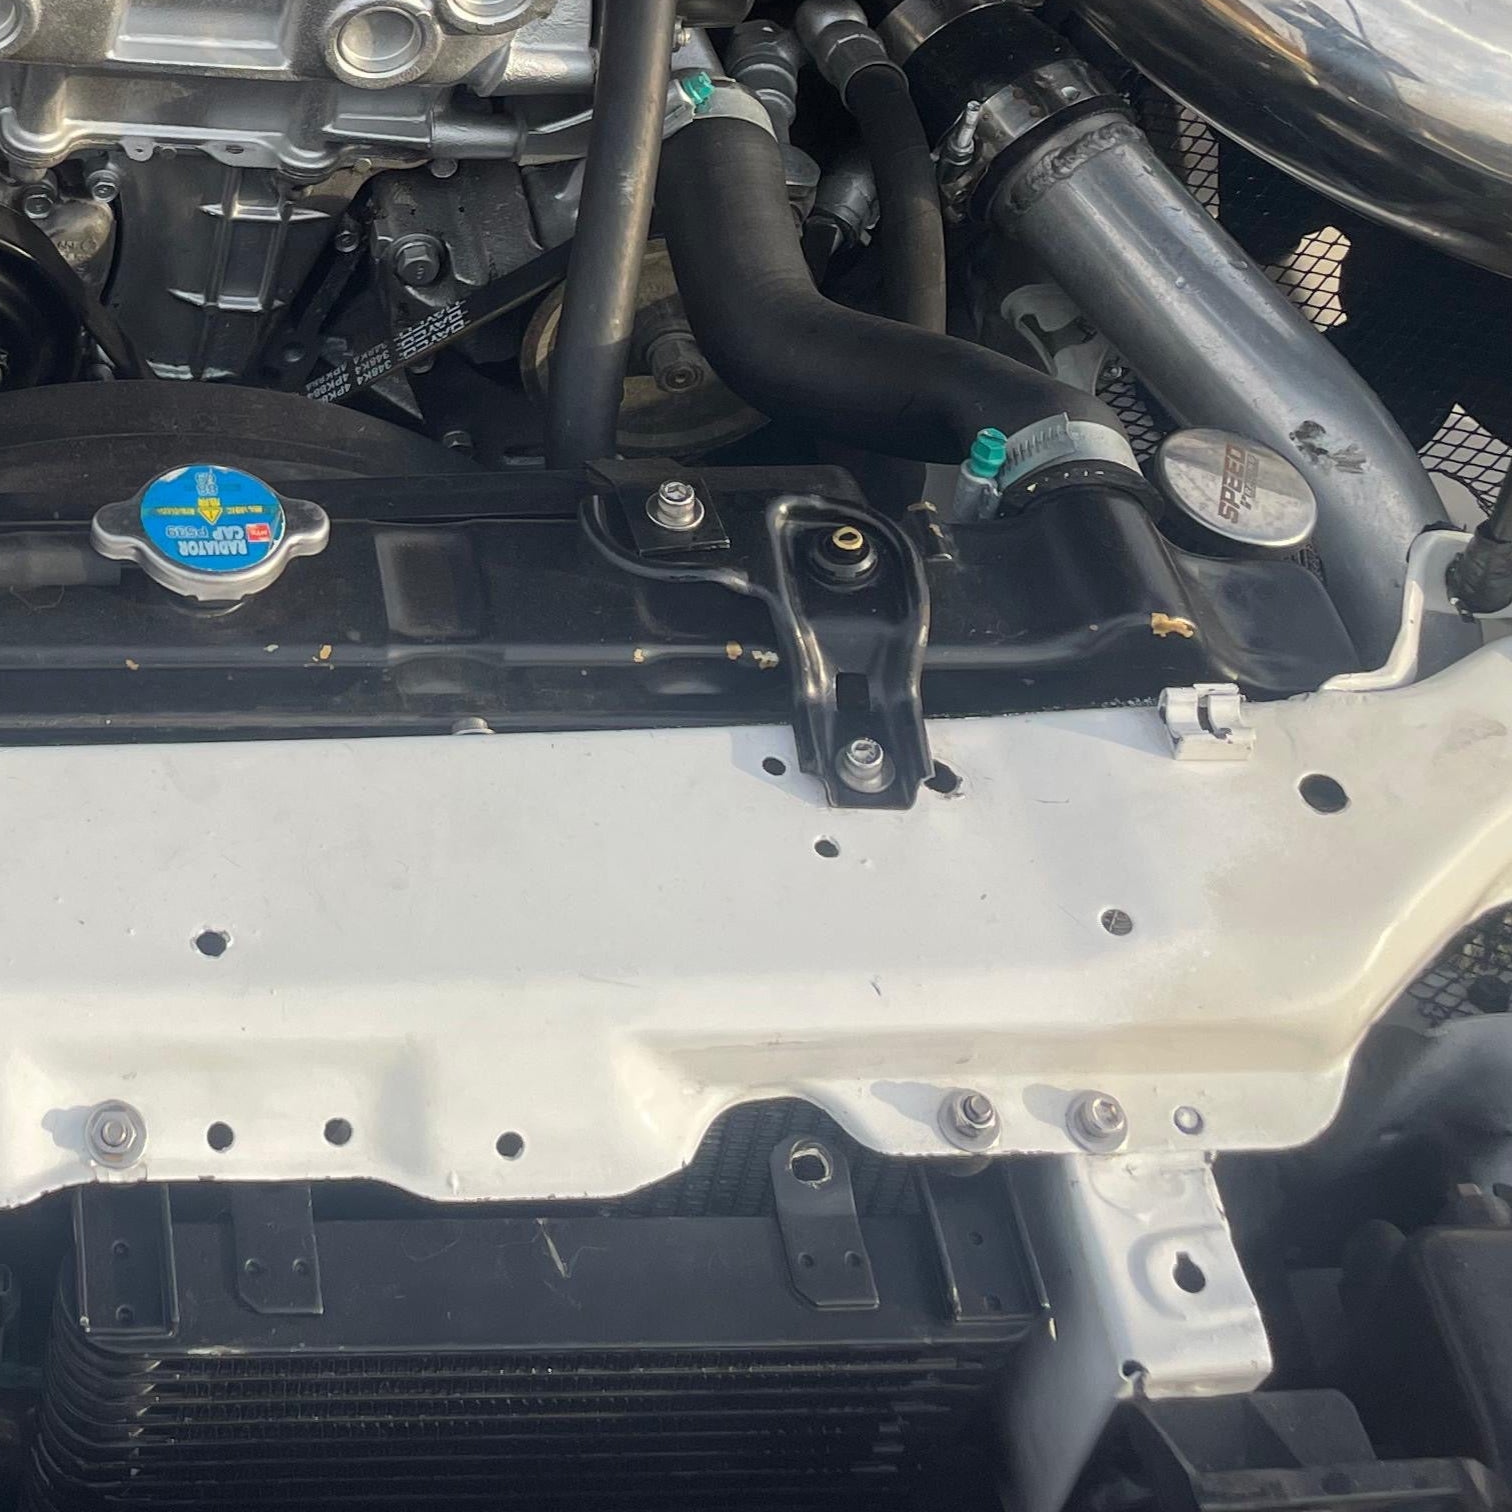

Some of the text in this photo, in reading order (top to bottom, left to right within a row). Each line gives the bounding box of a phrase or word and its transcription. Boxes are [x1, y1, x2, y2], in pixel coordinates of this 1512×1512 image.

[1218, 444, 1246, 524] SPEED
[213, 526, 245, 540] CAP
[179, 541, 248, 556] RADIATOR
